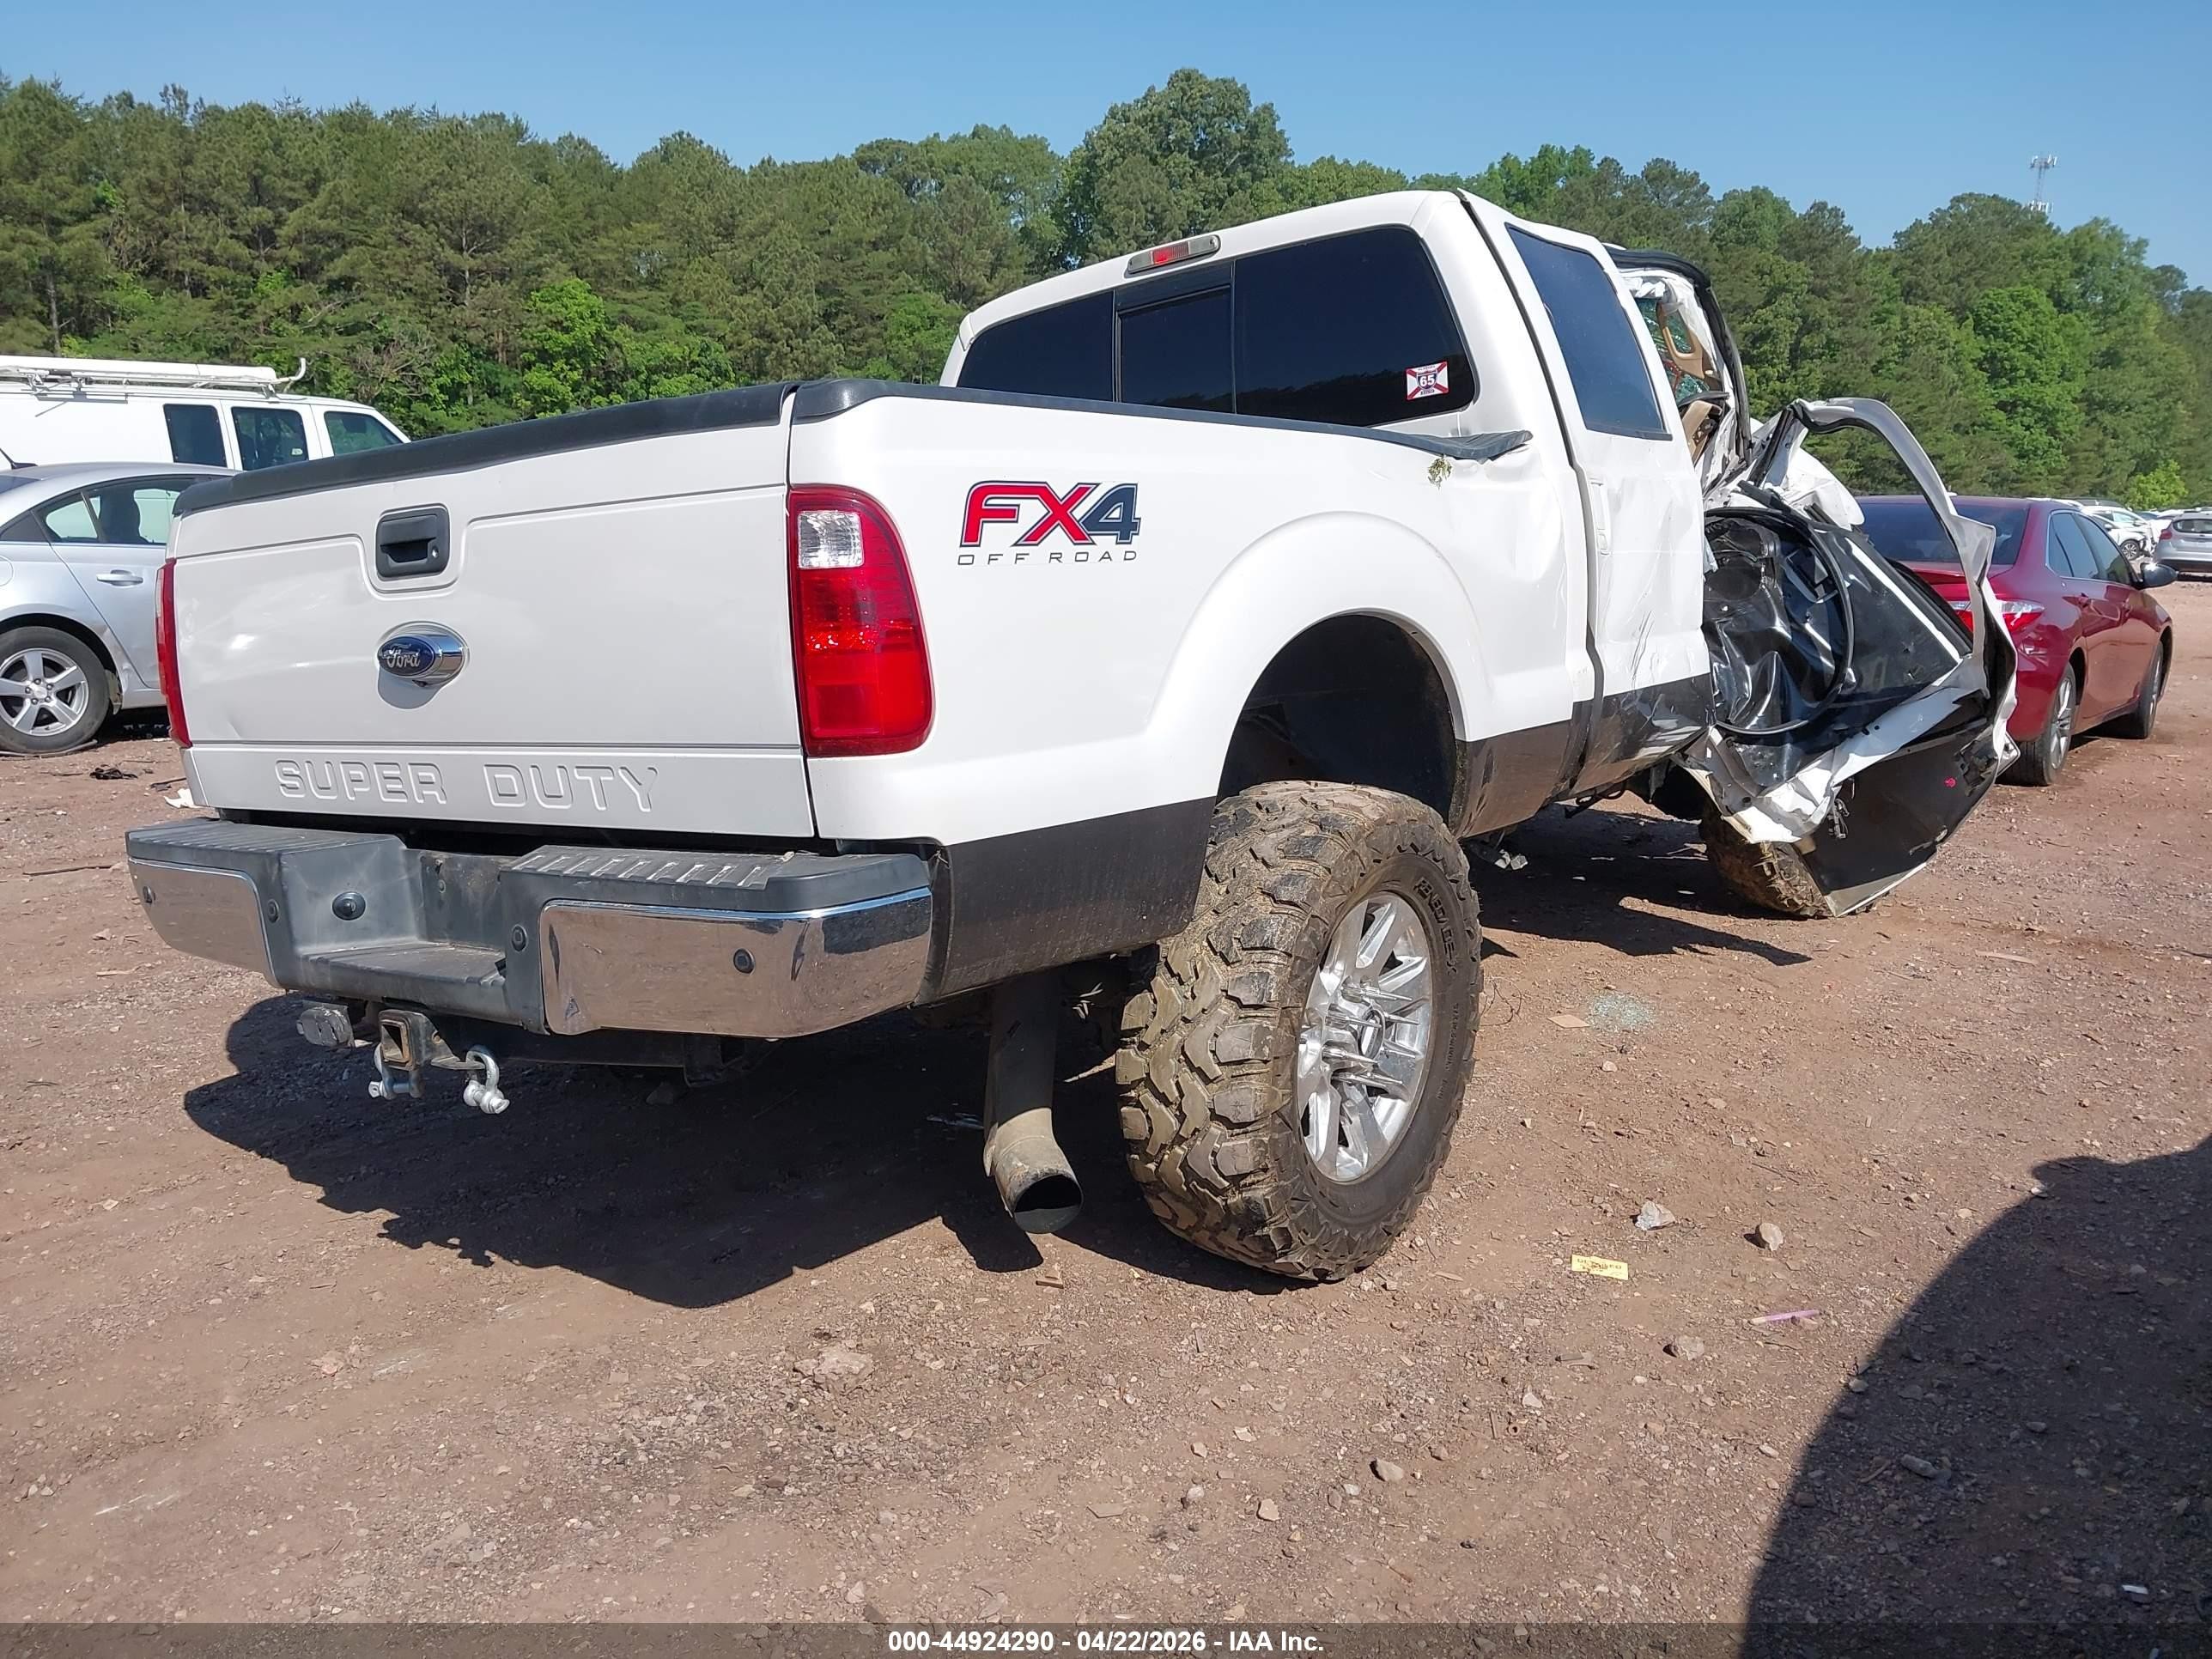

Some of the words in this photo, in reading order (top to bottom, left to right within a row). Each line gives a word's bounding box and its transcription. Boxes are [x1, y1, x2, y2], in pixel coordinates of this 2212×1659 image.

[1419, 374, 1435, 387] 65
[959, 480, 1141, 547] FX4
[957, 553, 1030, 566] OFF
[1048, 550, 1138, 564] ROAD
[384, 643, 421, 668] Ford
[274, 759, 447, 805] SUPER
[483, 763, 659, 812] DUTY
